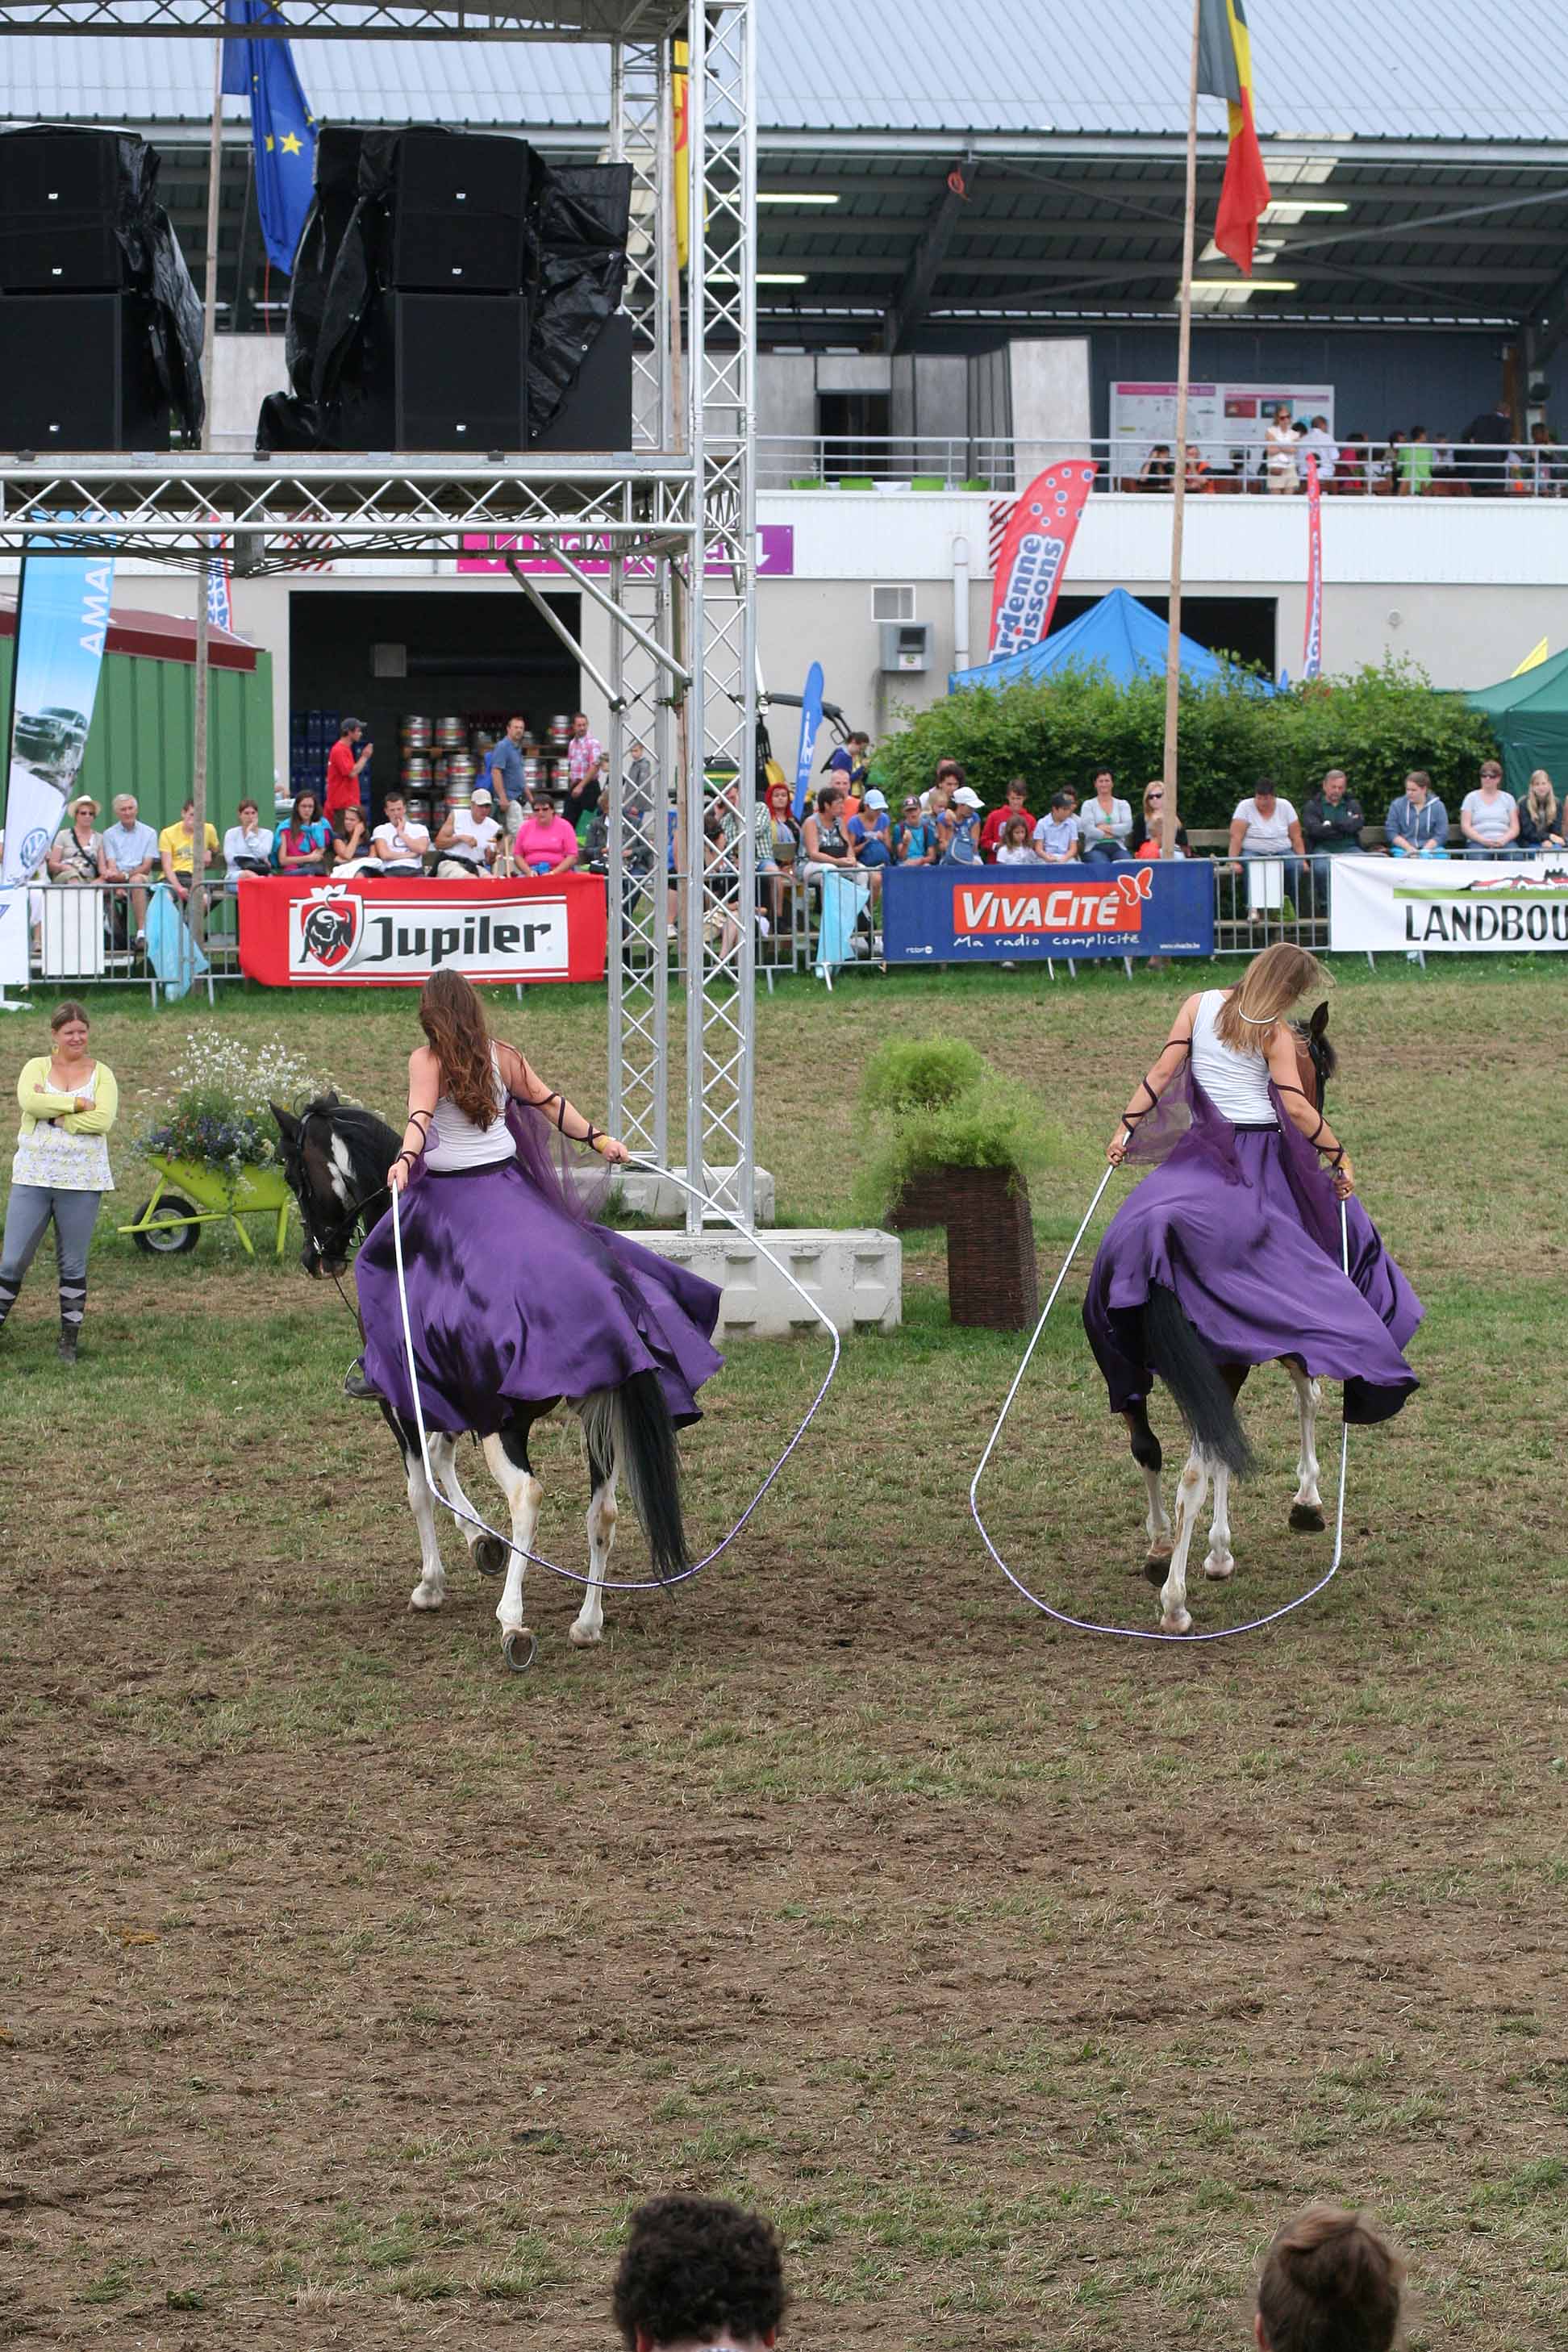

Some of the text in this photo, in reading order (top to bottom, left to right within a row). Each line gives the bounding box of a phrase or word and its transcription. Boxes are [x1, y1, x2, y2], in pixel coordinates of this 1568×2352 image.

[79, 557, 113, 659] AMA
[1017, 541, 1062, 651] oissons
[365, 915, 552, 966] Jupiler
[953, 932, 1141, 948] Ma radio complicité
[1405, 905, 1568, 941] LANDBOU
